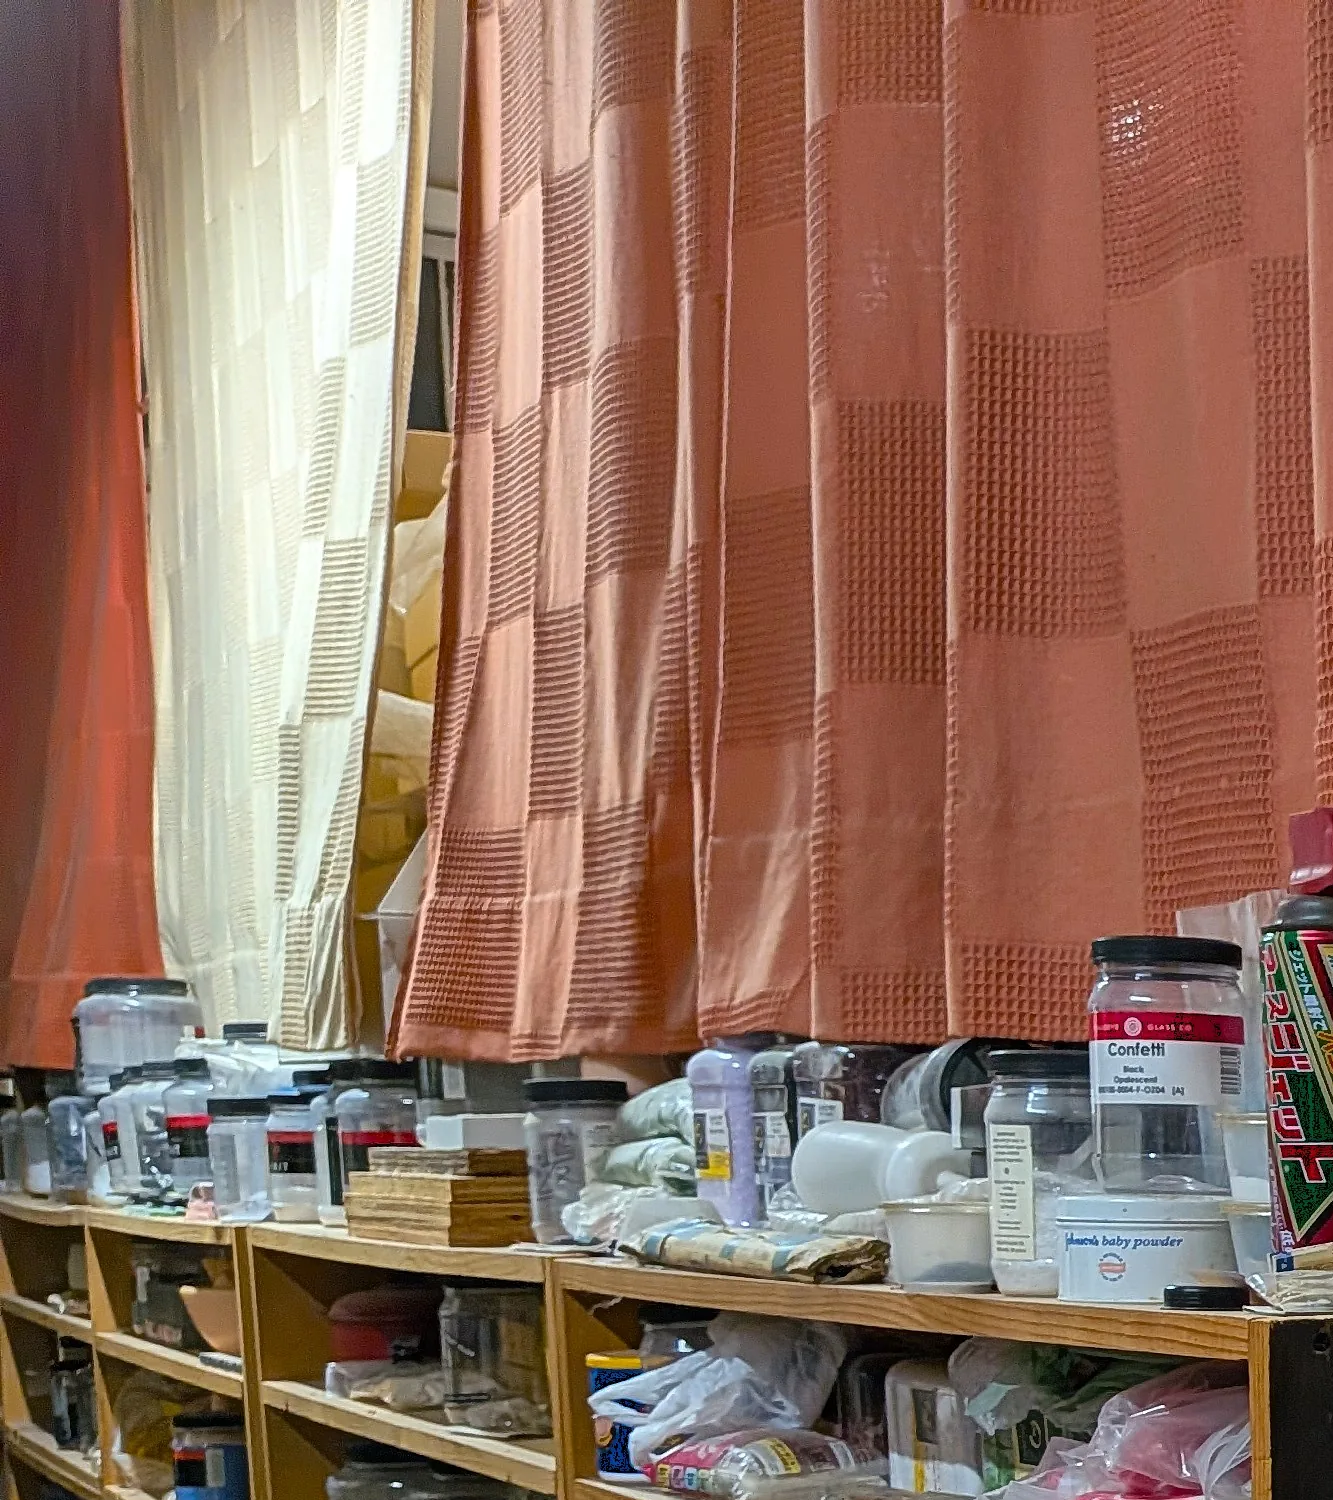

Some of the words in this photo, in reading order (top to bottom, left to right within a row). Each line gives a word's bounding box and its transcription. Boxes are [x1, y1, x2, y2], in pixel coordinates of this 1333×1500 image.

[1107, 1041, 1166, 1057] Confetti
[1101, 1235, 1132, 1250] baby
[1132, 1235, 1184, 1251] powder
